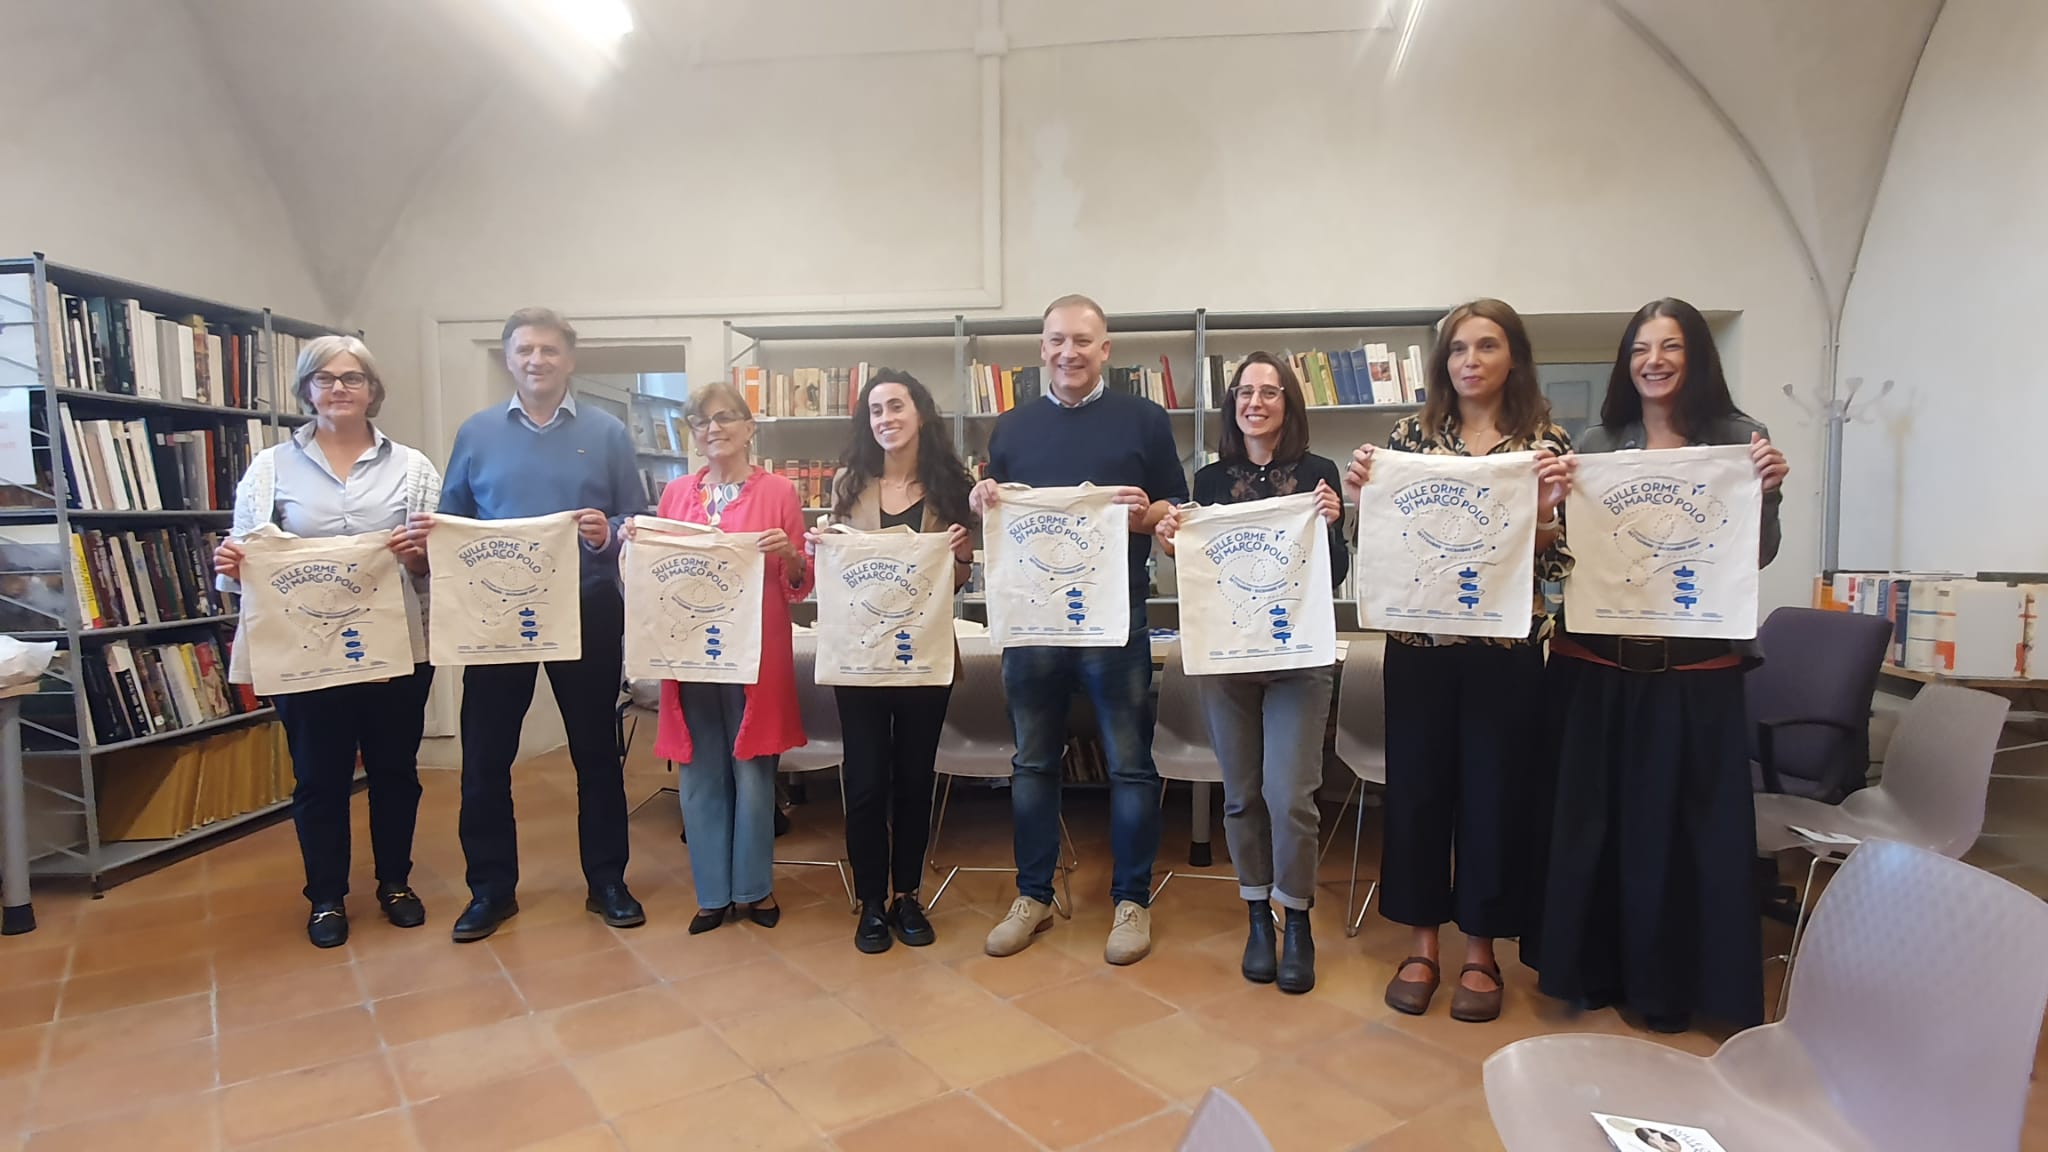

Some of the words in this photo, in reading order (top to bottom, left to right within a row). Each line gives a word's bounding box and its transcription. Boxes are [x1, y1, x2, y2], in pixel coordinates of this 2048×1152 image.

[1394, 486, 1428, 508] SULLE
[1430, 484, 1467, 498] ORME
[1603, 485, 1638, 509] SULLE
[1641, 483, 1680, 495] ORME
[1611, 503, 1624, 515] DI
[1625, 493, 1674, 506] MARCO
[1674, 498, 1706, 523] POLO
[1401, 503, 1413, 515] DI
[1415, 495, 1459, 509] MARCO
[1462, 500, 1489, 525] POLO
[1010, 517, 1035, 537] SULLE
[1037, 515, 1069, 526] ORME
[1016, 533, 1025, 544] DI
[1026, 525, 1063, 537] MARCO
[1064, 528, 1088, 550] POLO
[459, 542, 486, 561] SULLE
[489, 541, 520, 551] ORME
[1205, 535, 1234, 559] SULLE
[1234, 532, 1266, 542] ORME
[1212, 554, 1224, 565] DI
[1224, 541, 1261, 558] MARCO
[1263, 544, 1289, 565] POLO
[465, 558, 477, 568] DI
[477, 550, 515, 562] MARCO
[516, 553, 541, 574] POLO
[652, 558, 680, 576] SULLE
[681, 558, 710, 569] ORME
[843, 564, 869, 582] SULLE
[870, 562, 900, 572] ORME
[272, 567, 301, 588] SULLE
[303, 565, 337, 573] ORME
[280, 584, 292, 594] DI
[291, 573, 333, 588] MARCO
[335, 576, 362, 594] POLO
[658, 574, 669, 583] DI
[670, 567, 705, 577] MARCO
[706, 571, 728, 592] POLO
[848, 578, 859, 588] DI
[859, 571, 893, 582] MARCO
[894, 576, 918, 597] POLO
